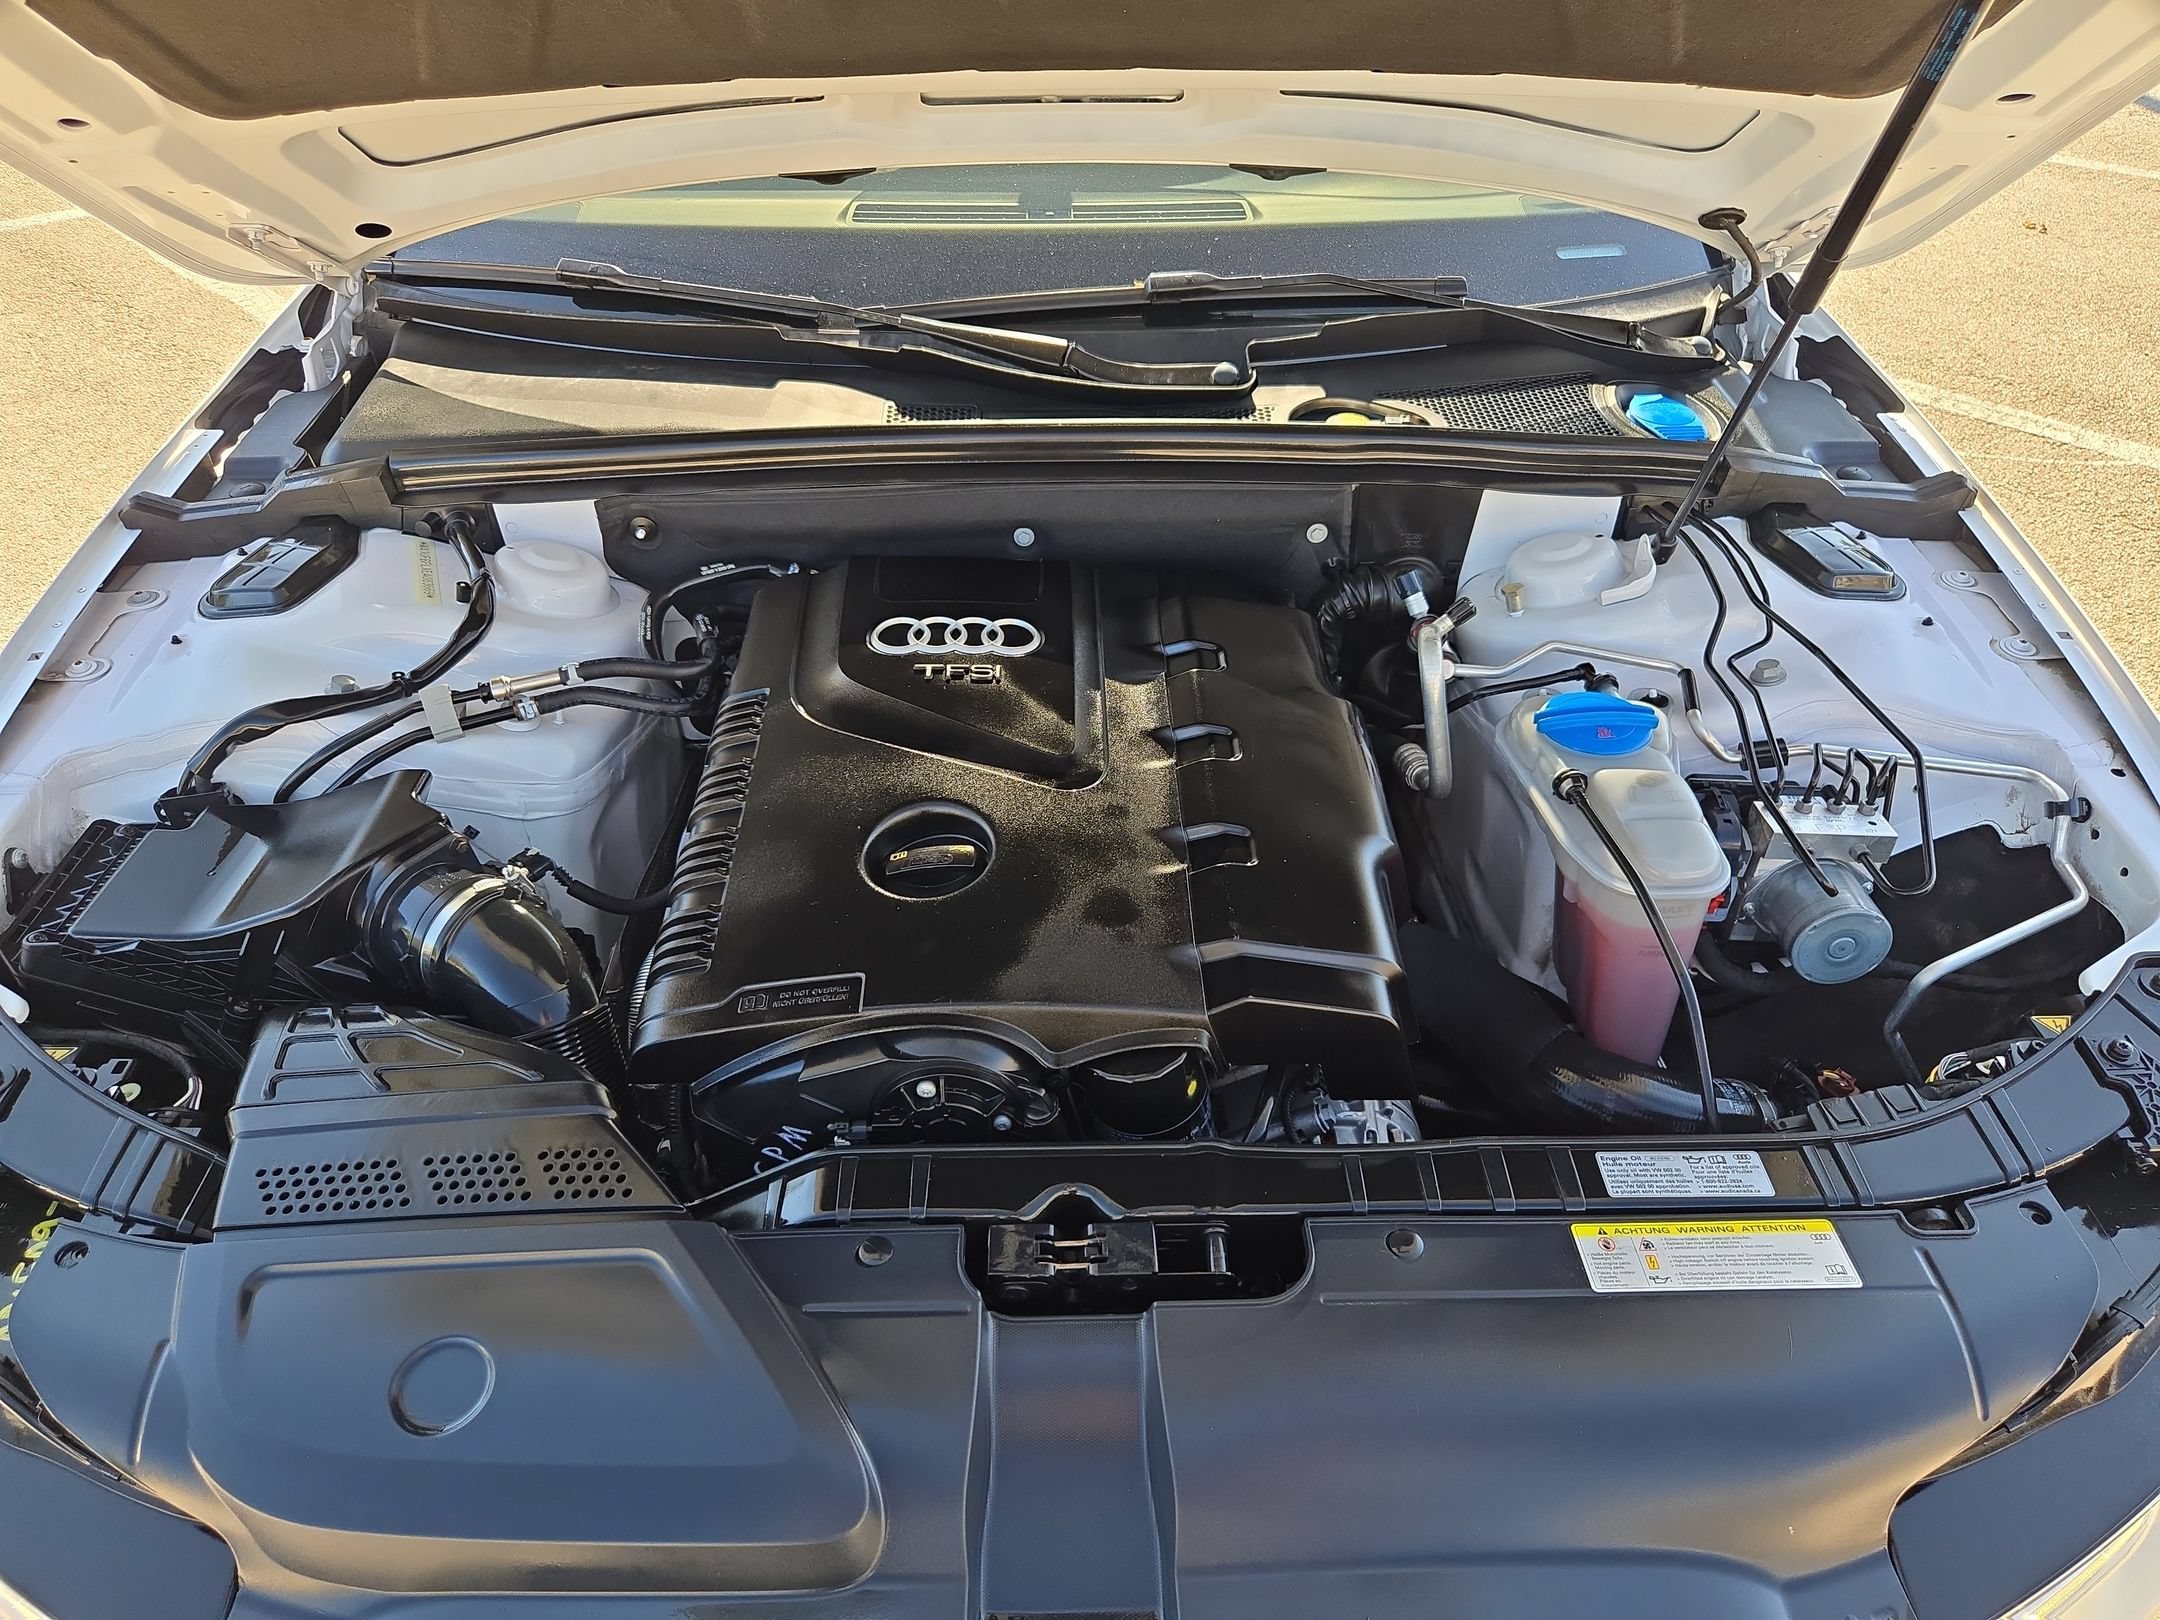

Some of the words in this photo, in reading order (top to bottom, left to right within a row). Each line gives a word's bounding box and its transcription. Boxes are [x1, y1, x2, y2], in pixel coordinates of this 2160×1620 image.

[913, 663, 1002, 682] TFSI
[779, 991, 792, 999] DO
[793, 989, 810, 997] NOT
[1614, 1227, 1670, 1235] ACHTUNG
[1676, 1225, 1735, 1233] WARNING
[1741, 1223, 1807, 1232] ATTENTION
